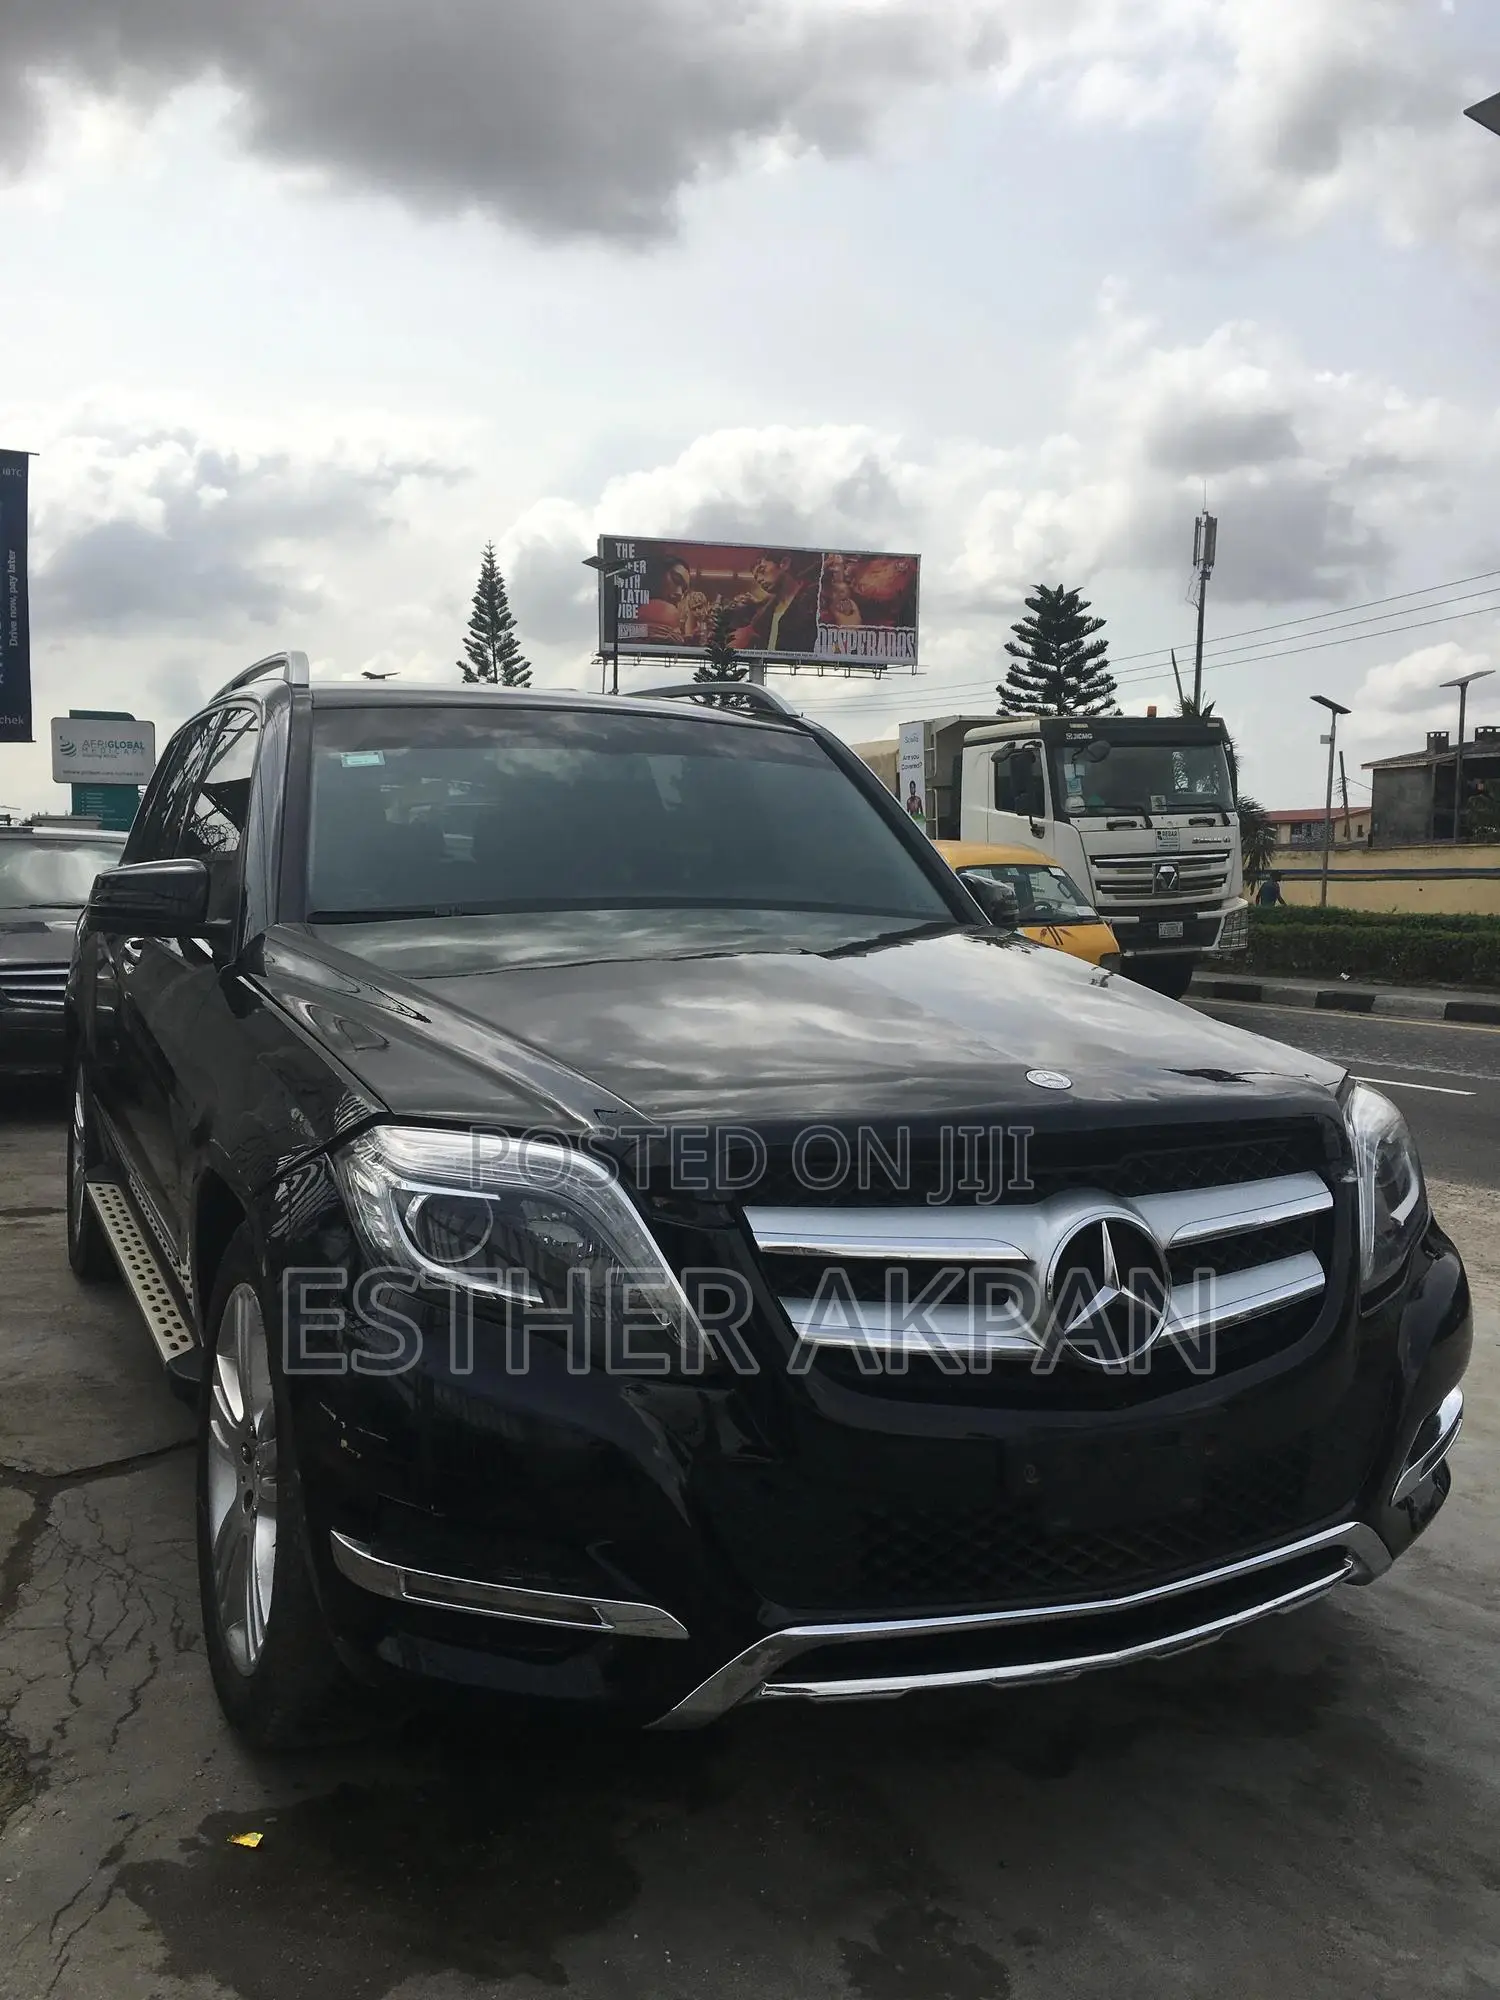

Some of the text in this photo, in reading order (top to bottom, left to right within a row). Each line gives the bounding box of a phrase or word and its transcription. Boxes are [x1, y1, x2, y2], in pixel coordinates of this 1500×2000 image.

[7, 549, 16, 574] later
[615, 543, 636, 559] THE
[8, 575, 19, 594] pay
[620, 589, 651, 605] LATIN
[8, 621, 18, 647] Drive
[817, 627, 917, 659] DESPERADOS
